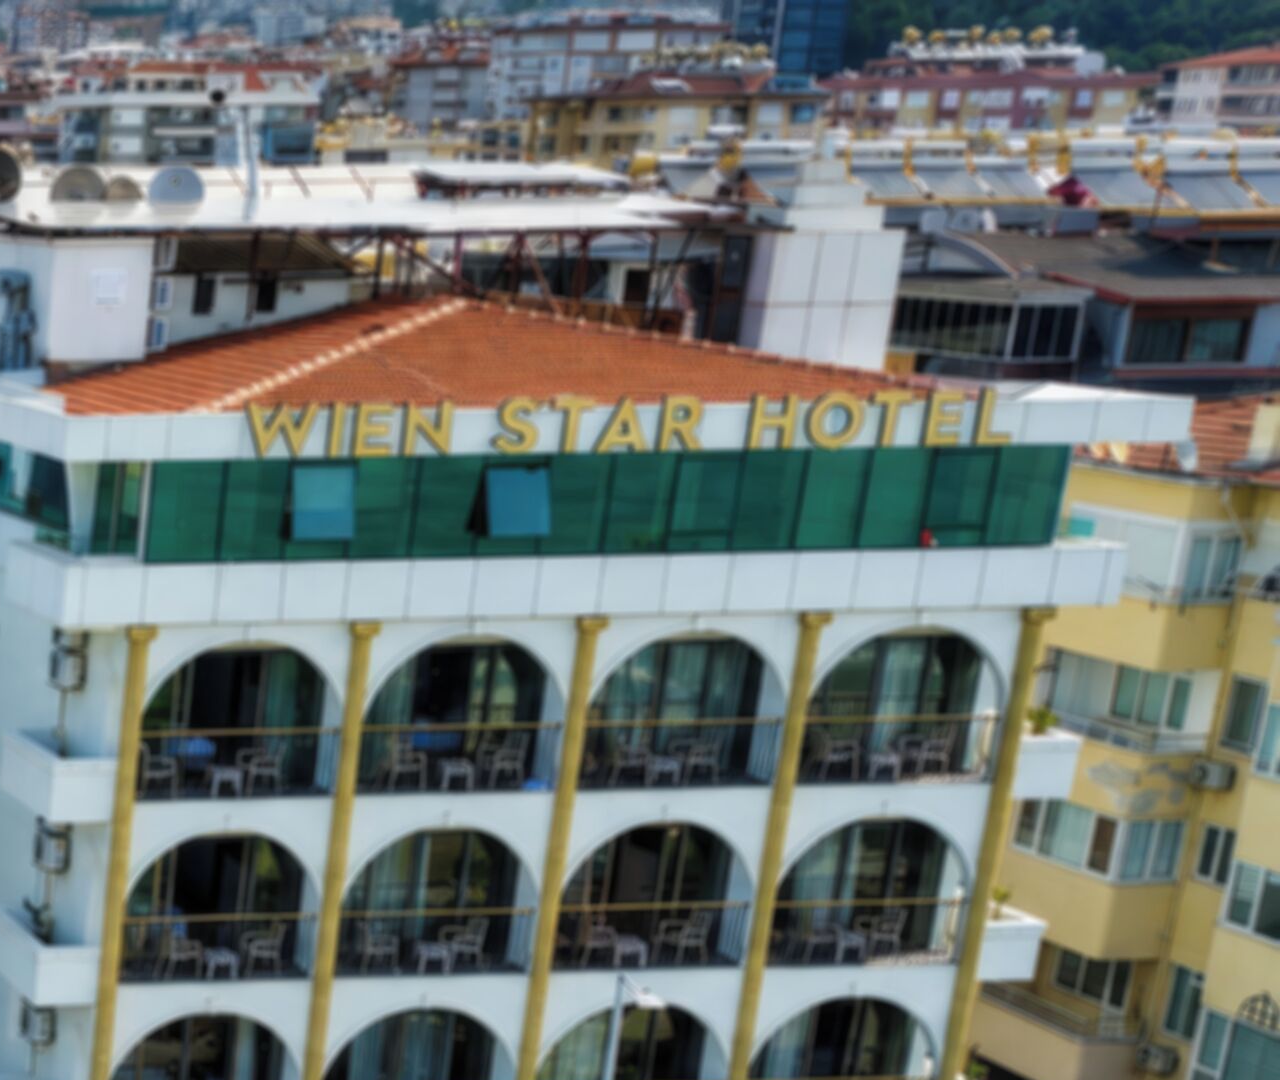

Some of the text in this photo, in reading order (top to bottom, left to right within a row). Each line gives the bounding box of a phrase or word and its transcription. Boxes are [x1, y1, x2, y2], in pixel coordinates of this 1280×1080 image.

[245, 388, 1014, 459] WIEN STAR HOTEL
